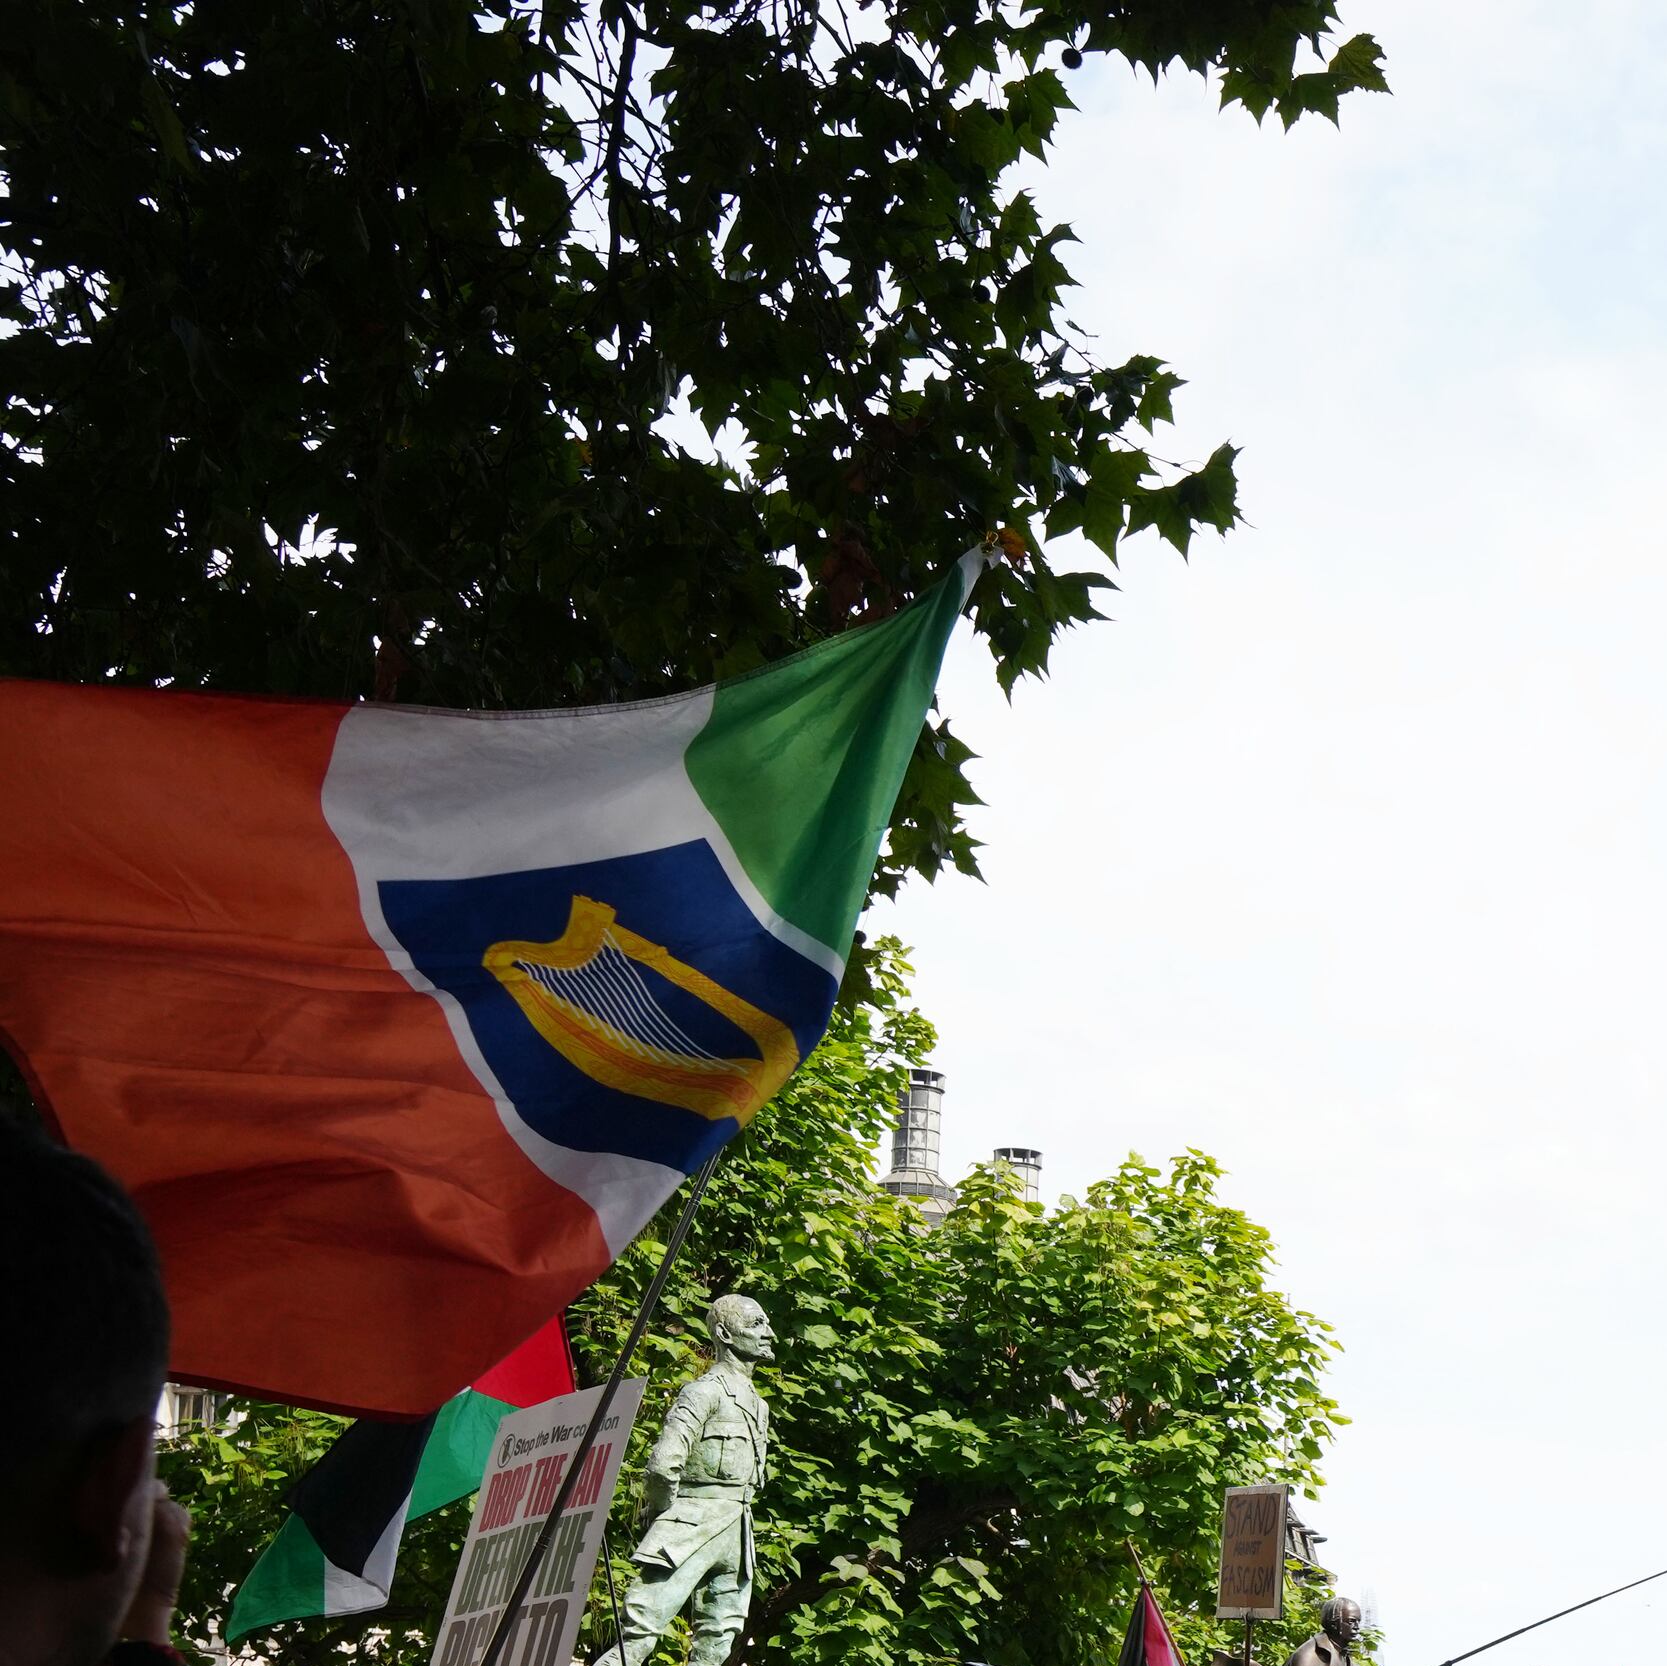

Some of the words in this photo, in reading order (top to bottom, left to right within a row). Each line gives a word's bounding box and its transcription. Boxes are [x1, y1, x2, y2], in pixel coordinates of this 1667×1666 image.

[513, 1436, 536, 1457] Stop
[535, 1430, 550, 1448] the
[550, 1425, 572, 1443] War
[572, 1415, 620, 1438] coion
[478, 1463, 533, 1533] DROP
[523, 1452, 569, 1519] THE
[566, 1443, 613, 1508] AN
[1227, 1493, 1277, 1539] STAND
[1221, 1564, 1275, 1597] FASCISM
